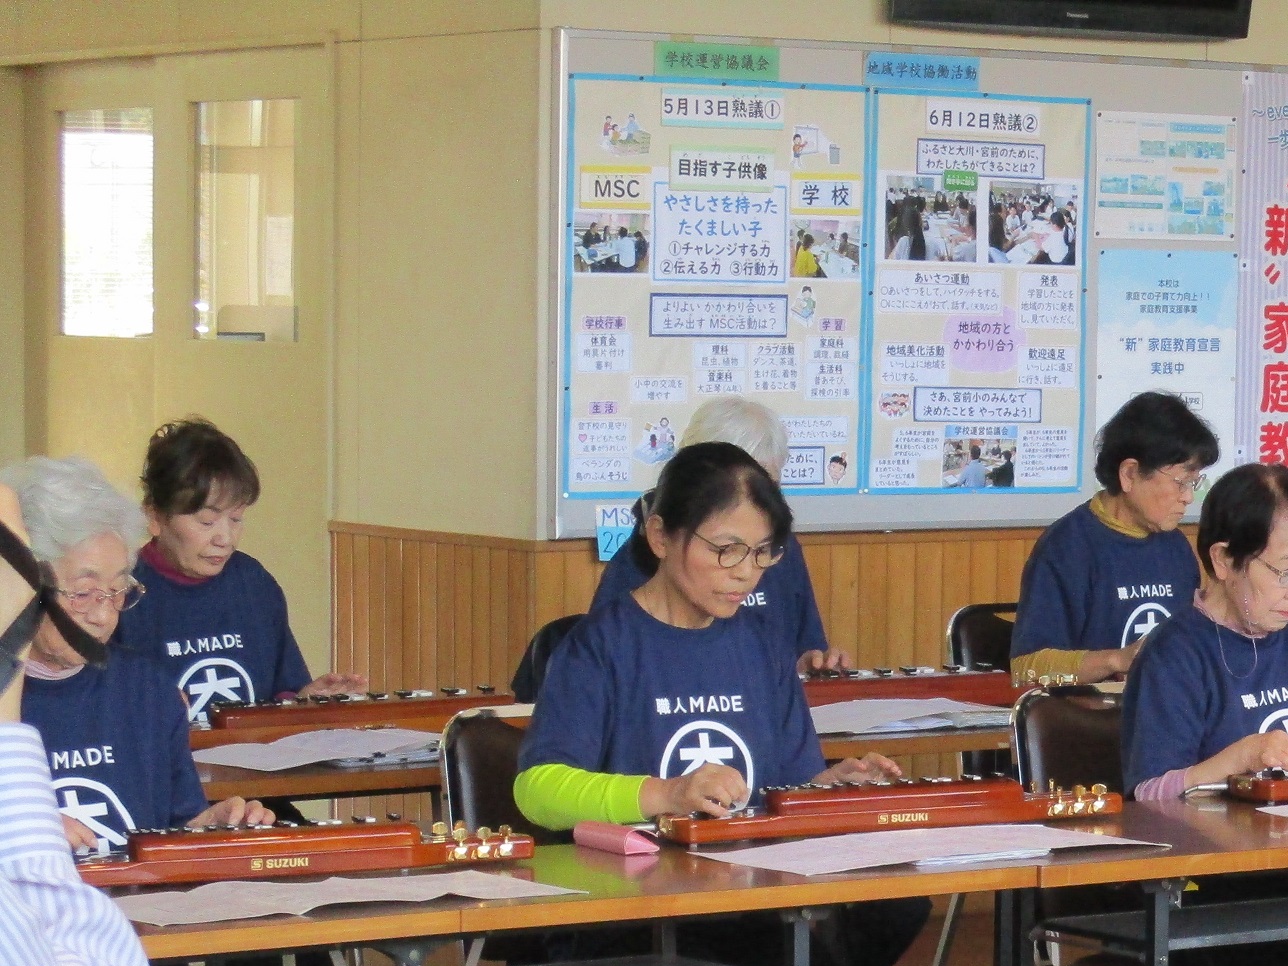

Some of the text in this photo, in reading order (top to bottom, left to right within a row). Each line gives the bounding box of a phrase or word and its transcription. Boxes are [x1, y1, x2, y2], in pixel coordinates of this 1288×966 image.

[665, 51, 770, 72] 学校運営協議会
[866, 60, 978, 81] 地域学校協働活動
[678, 158, 768, 180] 目指す子供像
[594, 179, 640, 199] MSC
[802, 184, 850, 207] 学校
[664, 194, 778, 214] やさしさを持った
[678, 218, 762, 238] たくましい子
[914, 272, 970, 285] あいさつ運動
[1040, 275, 1058, 287] 発表
[1157, 279, 1179, 289] 本校は
[958, 321, 1011, 335] 地域の方と
[886, 345, 945, 357] 地域美化活動
[953, 338, 1014, 352] かかわり合う
[1148, 337, 1221, 352] 家庭教育宣言
[1150, 361, 1185, 374] 実践中
[53, 745, 115, 770] MADE
[890, 812, 929, 823] SUZUKI
[265, 856, 309, 869] SUZUKI
